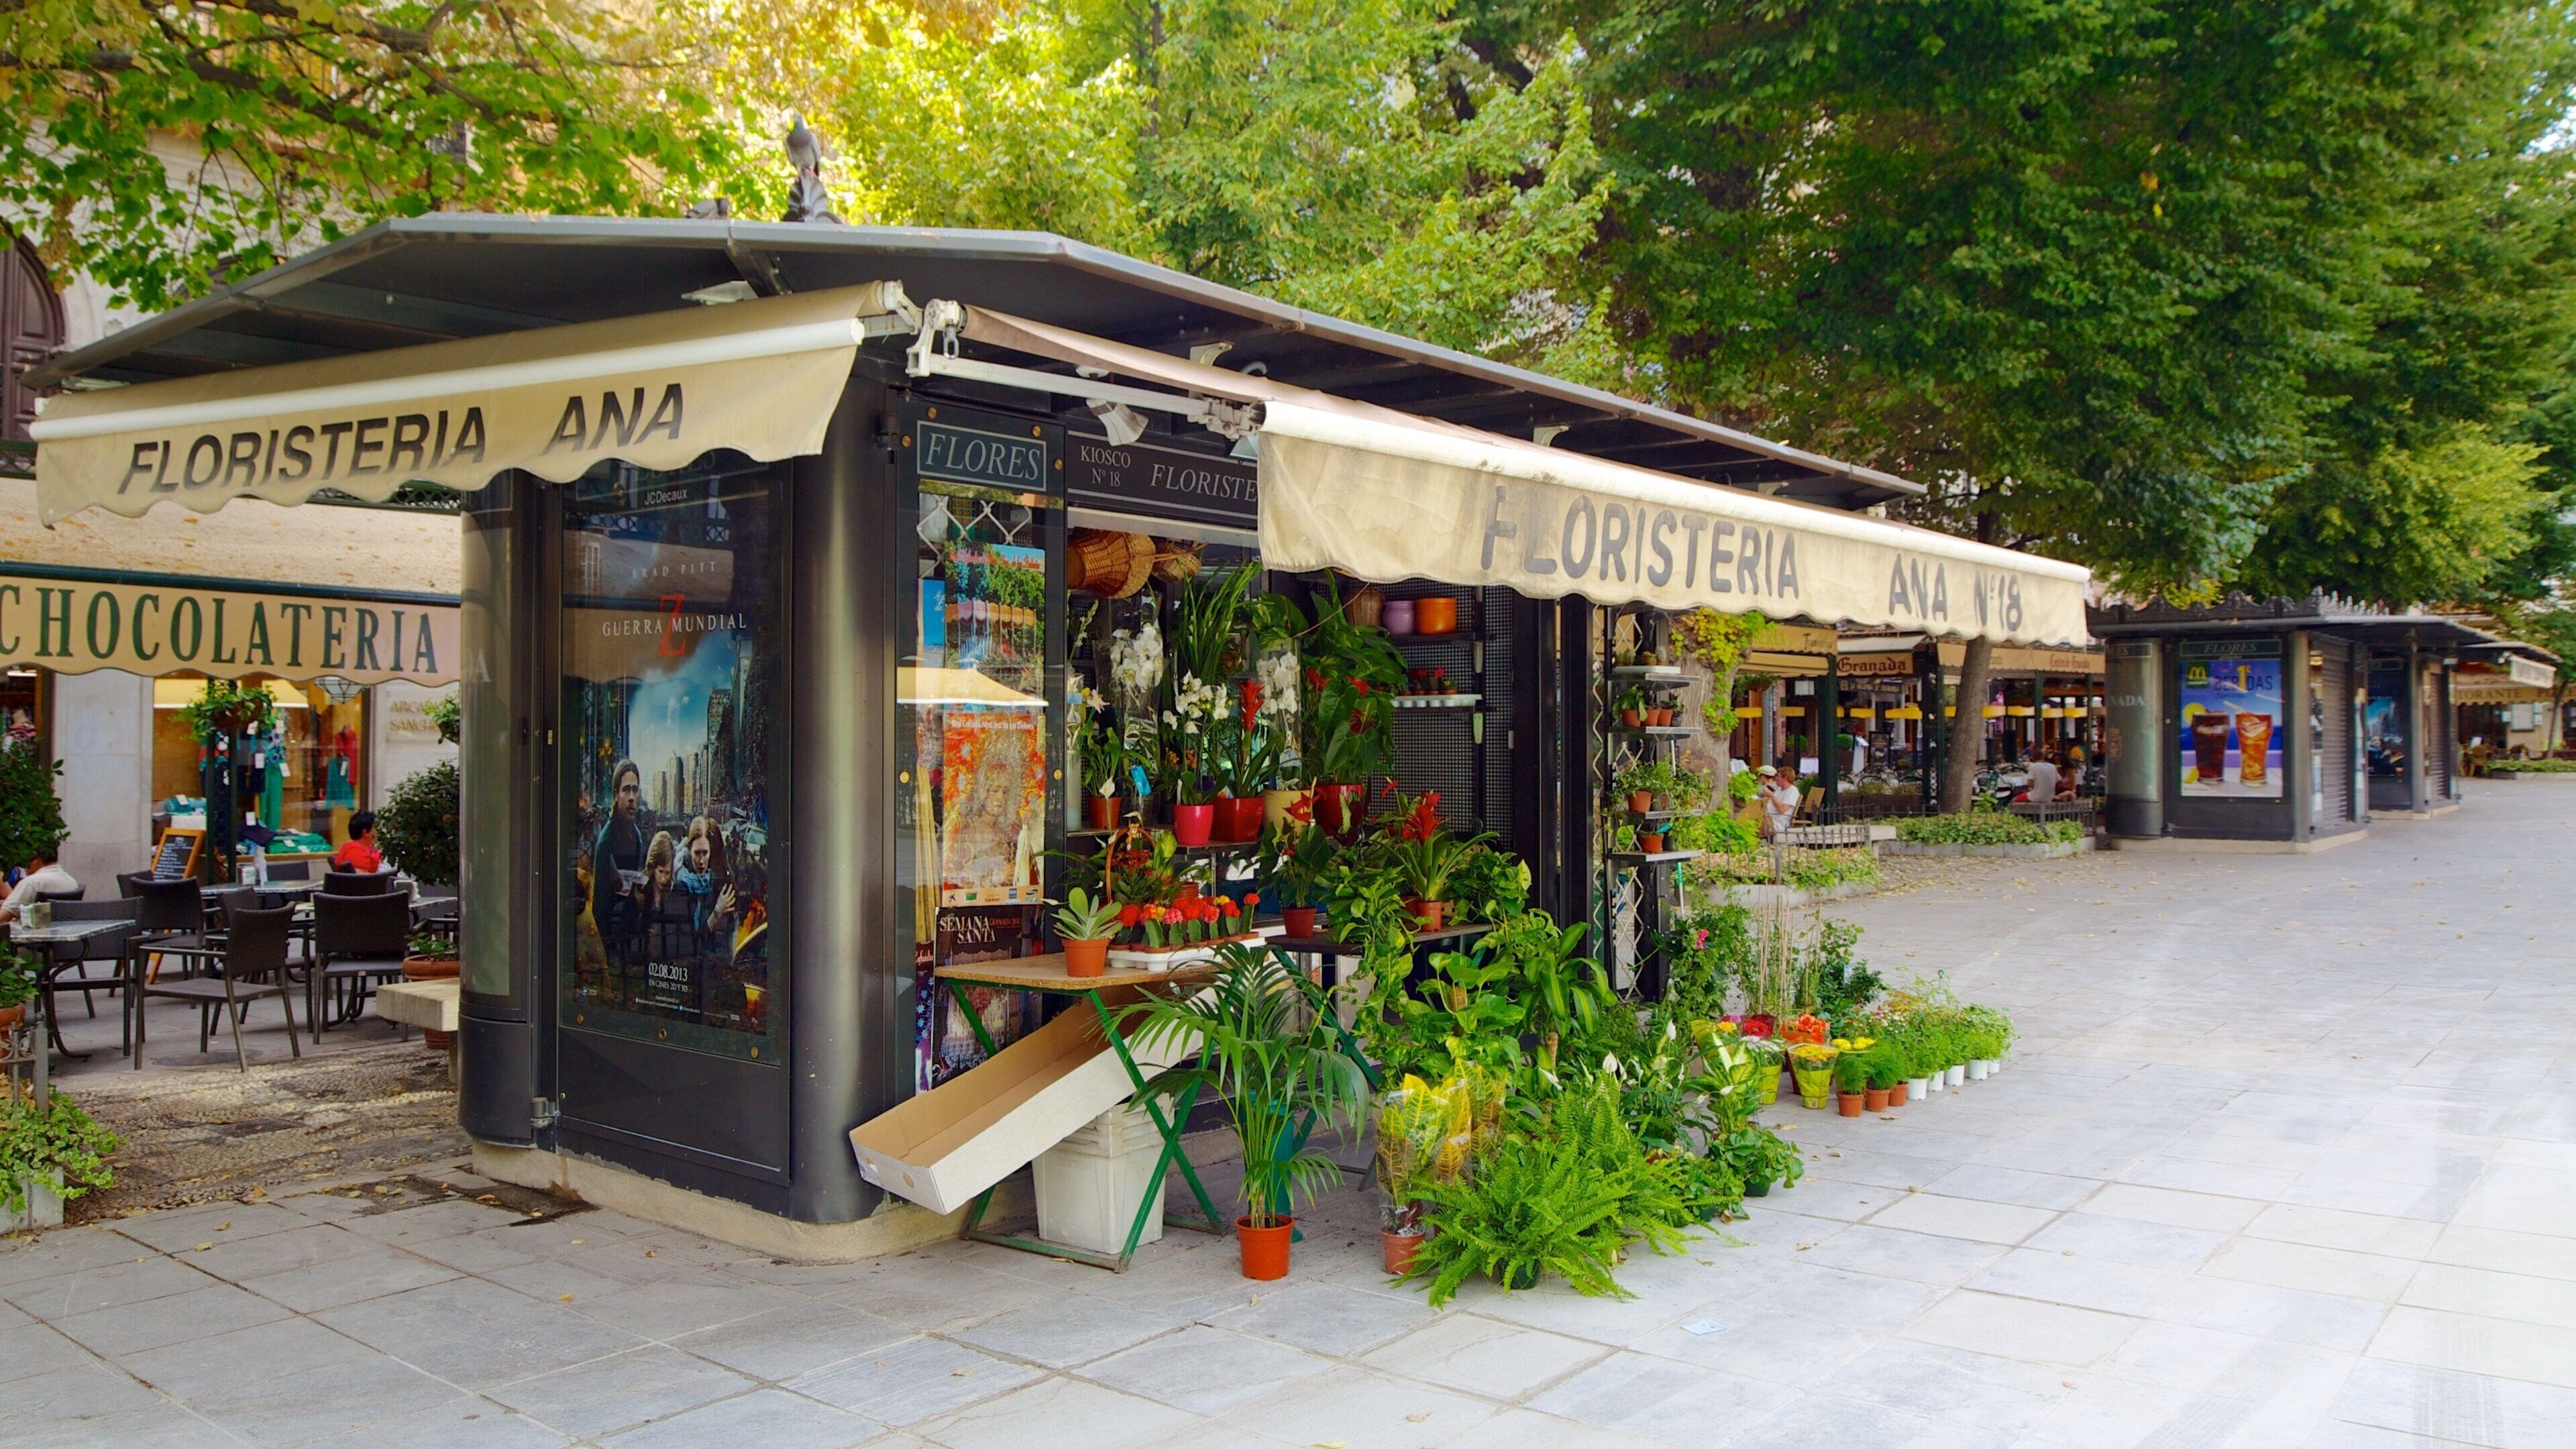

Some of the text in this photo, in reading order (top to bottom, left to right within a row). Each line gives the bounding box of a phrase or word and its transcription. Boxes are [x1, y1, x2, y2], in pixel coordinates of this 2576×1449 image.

[117, 383, 683, 494] FLORISTERIA ANA
[924, 433, 1040, 480] FLORES
[1081, 445, 1131, 468] KIOSCO
[1110, 472, 1121, 487] 18
[1150, 464, 1257, 502] FLORISTE
[645, 489, 688, 505] JCDecaux
[1481, 486, 1799, 599] FLORISTERIA
[1888, 553, 1948, 622] ANA
[632, 561, 716, 578] BRAD PITT
[0, 584, 438, 674] CHOCOLATERIA
[602, 613, 747, 637] GUERRA MUNDIAL
[658, 593, 686, 656] Z
[2204, 642, 2257, 655] FLORES
[1837, 657, 1907, 673] Granada
[939, 916, 991, 932] SEMANA
[957, 928, 996, 945] SANTA
[648, 962, 688, 982] 02.08.2013
